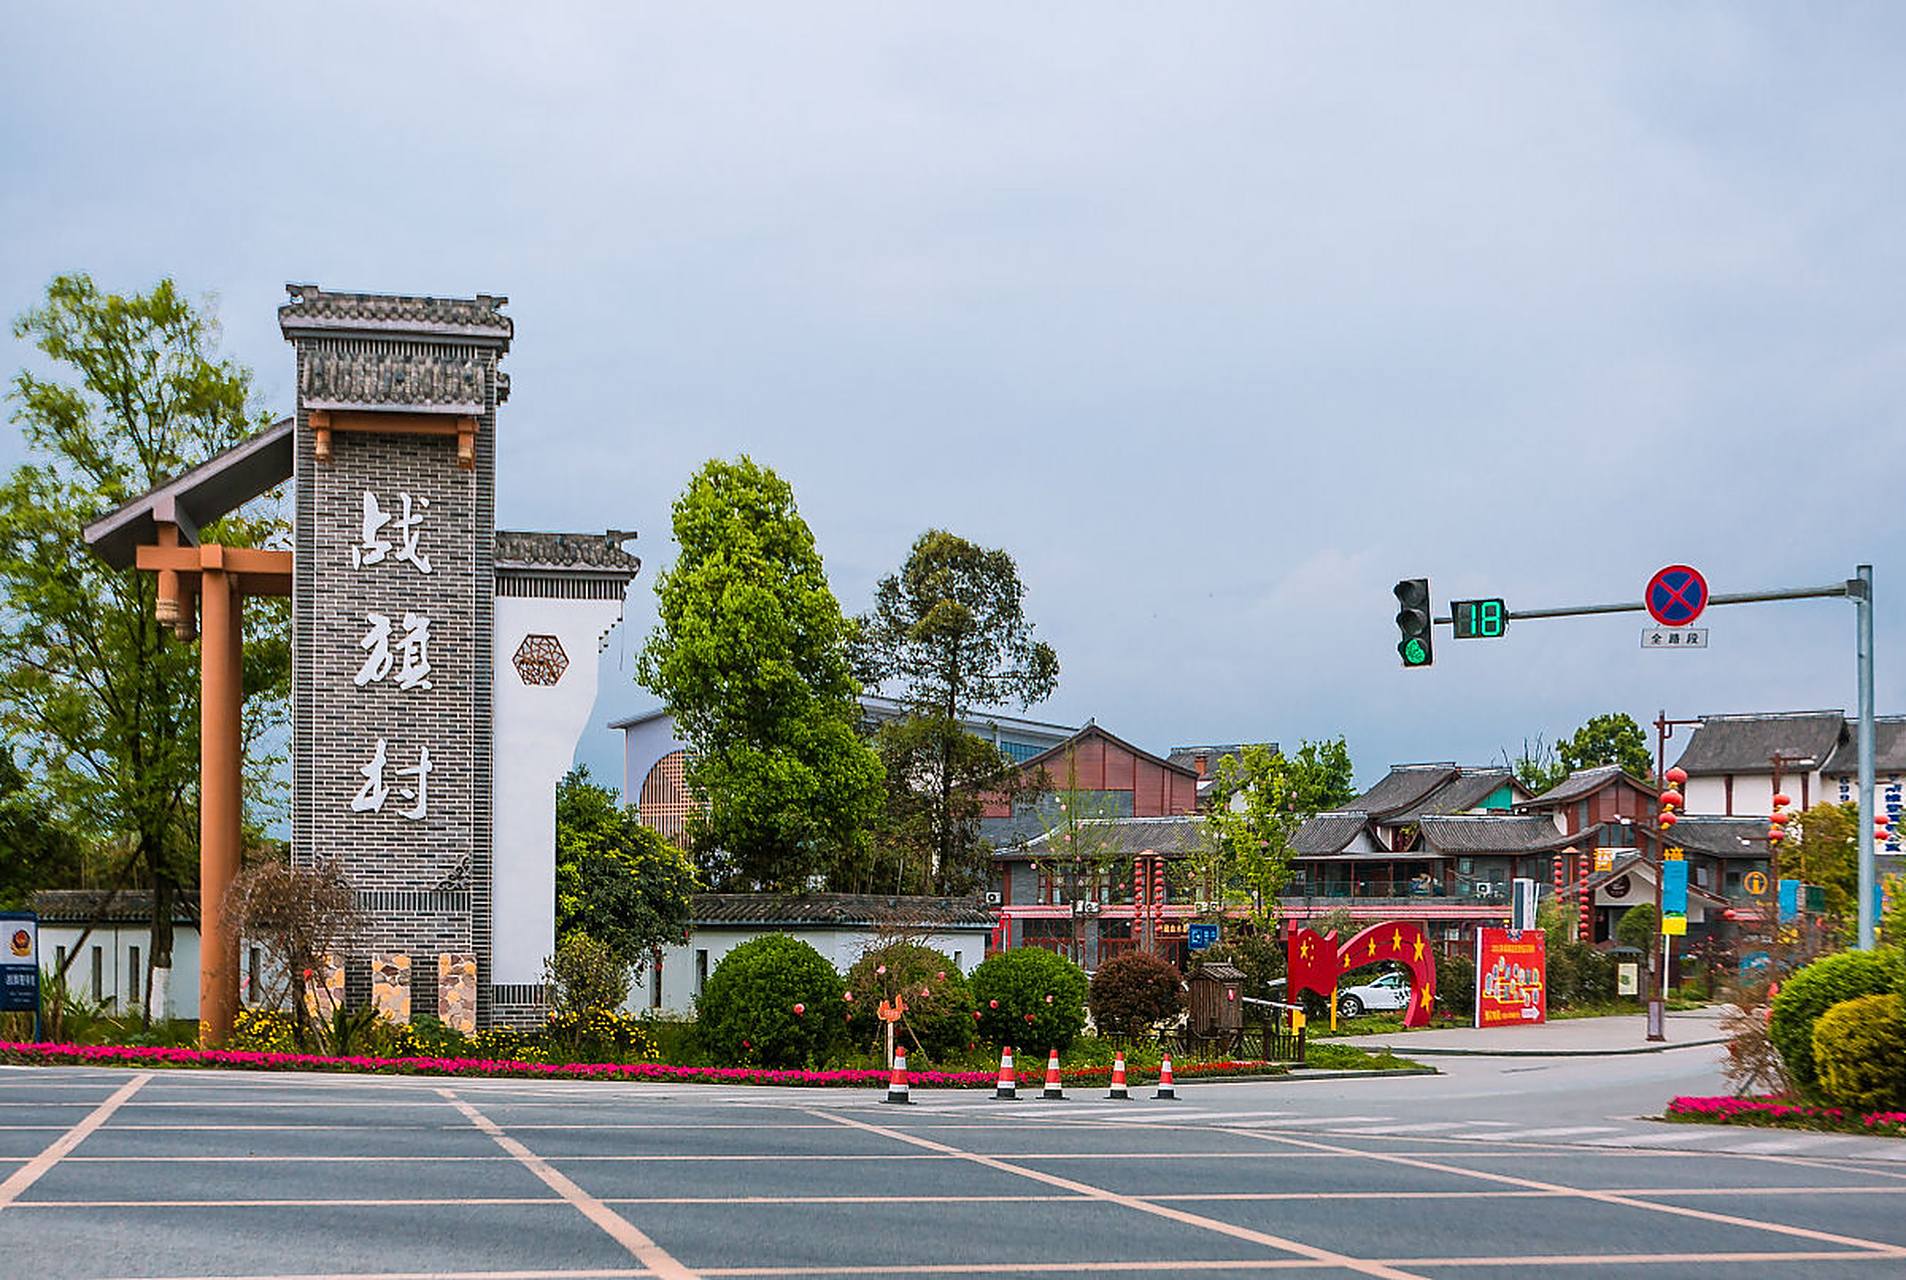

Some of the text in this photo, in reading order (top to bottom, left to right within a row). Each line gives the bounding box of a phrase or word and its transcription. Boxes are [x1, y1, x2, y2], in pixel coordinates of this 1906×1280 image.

[1471, 601, 1500, 636] 18
[351, 491, 432, 820] 战旗村
[1651, 632, 1699, 645] 全路段
